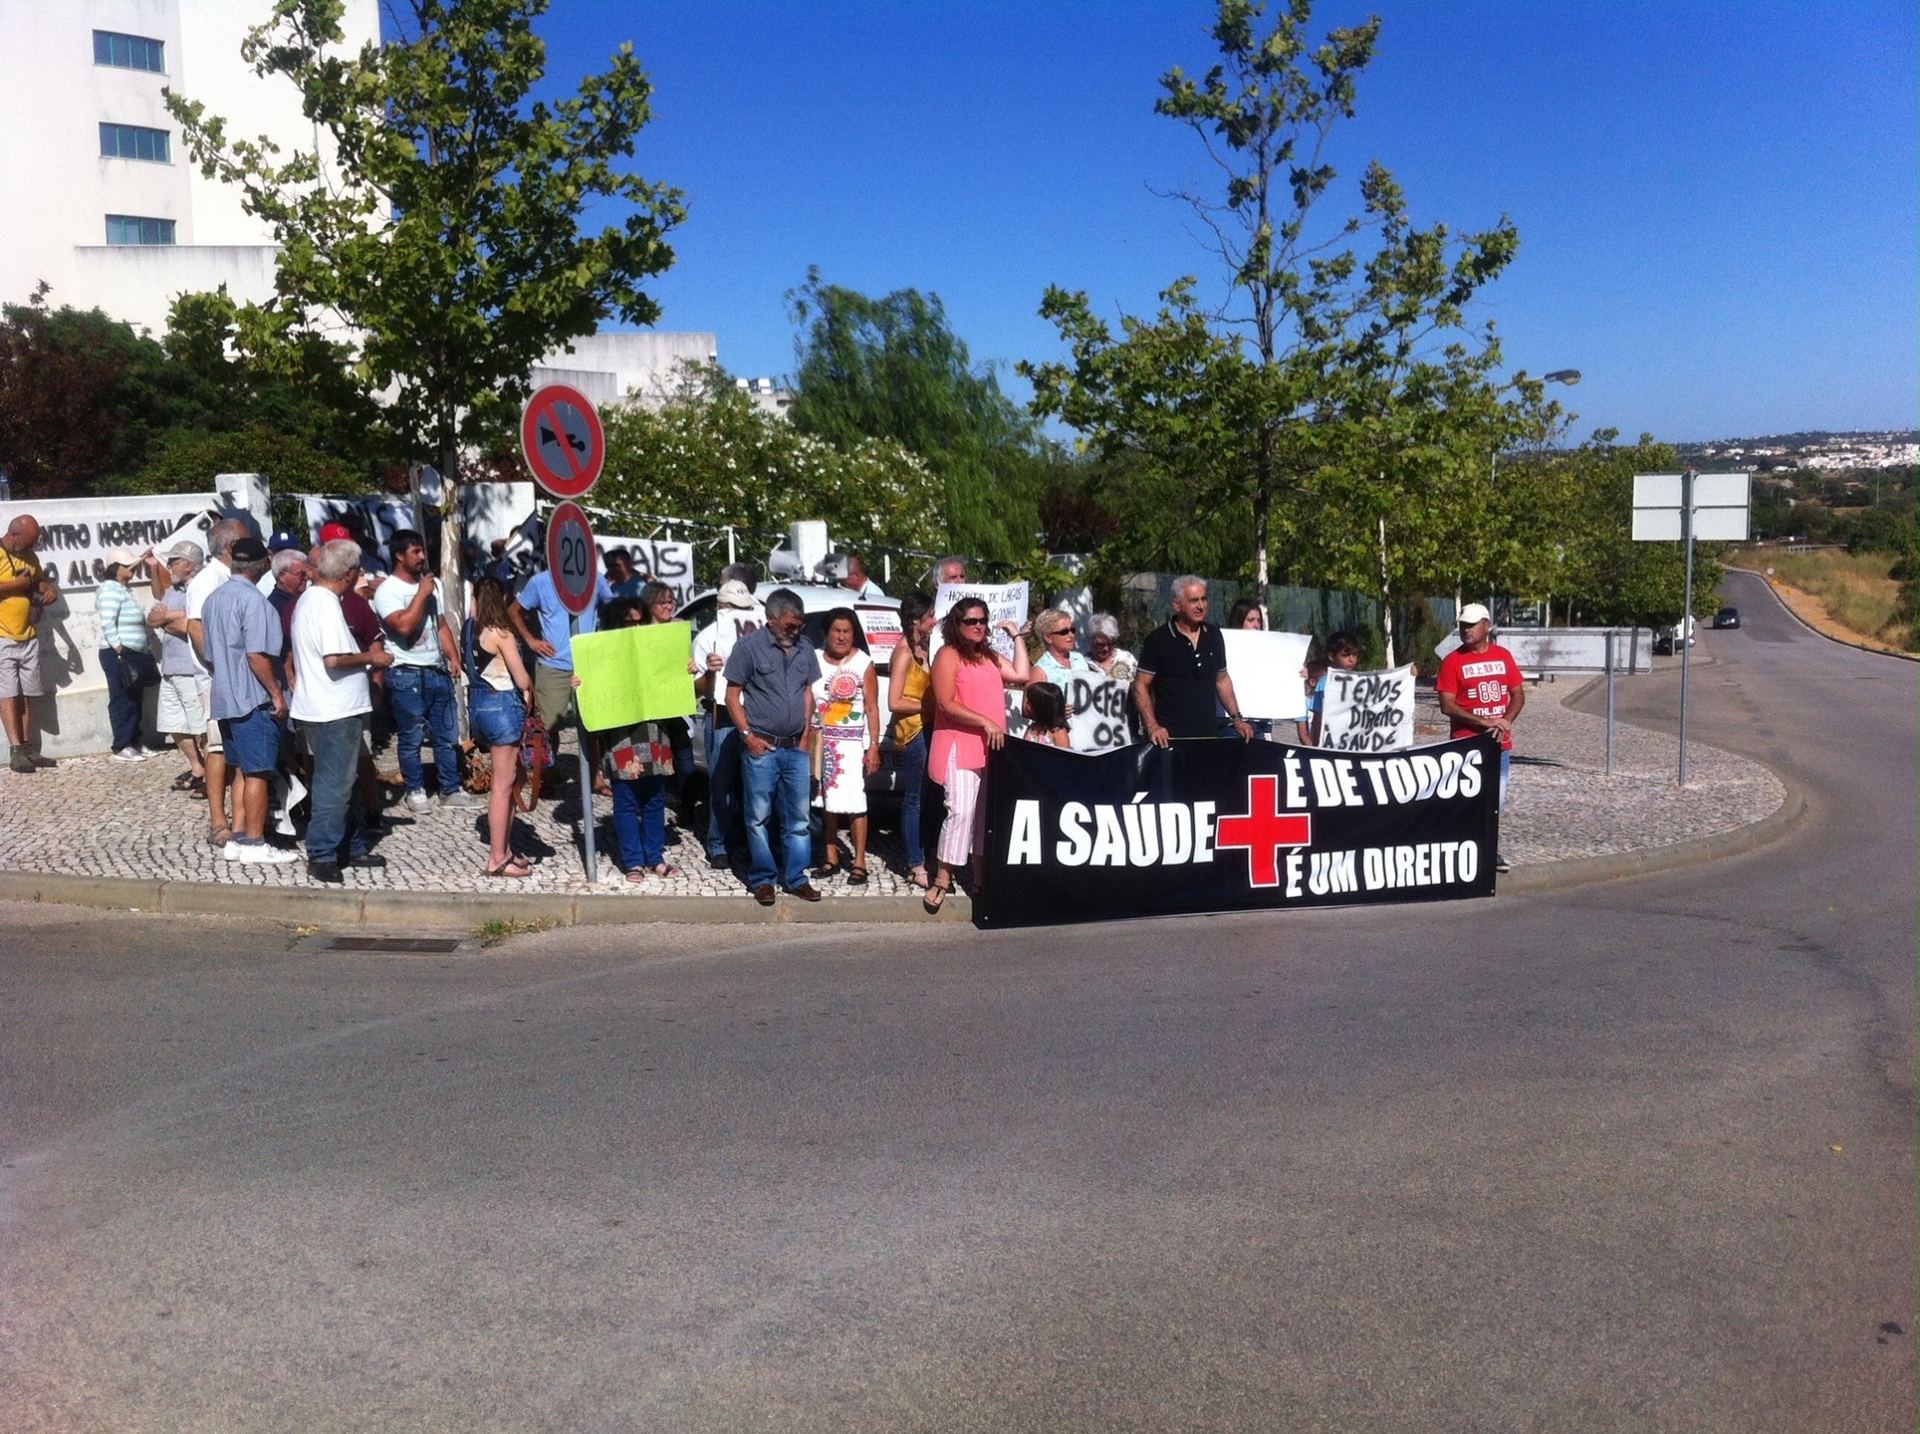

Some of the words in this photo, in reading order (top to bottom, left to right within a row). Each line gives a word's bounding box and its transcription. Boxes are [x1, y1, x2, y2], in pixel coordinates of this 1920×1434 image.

[561, 537, 587, 577] 20
[988, 592, 999, 603] DE
[1334, 674, 1402, 704] TEMOS
[1478, 681, 1501, 703] 89
[1093, 722, 1126, 748] OS
[1284, 750, 1307, 808] É
[1309, 758, 1364, 807] DE
[1360, 749, 1483, 805] TODOS
[1007, 799, 1042, 864] A
[1056, 791, 1216, 867] SAÚDE
[1286, 847, 1303, 898] É
[1308, 849, 1358, 895] UM
[1363, 840, 1478, 890] DIREITO
